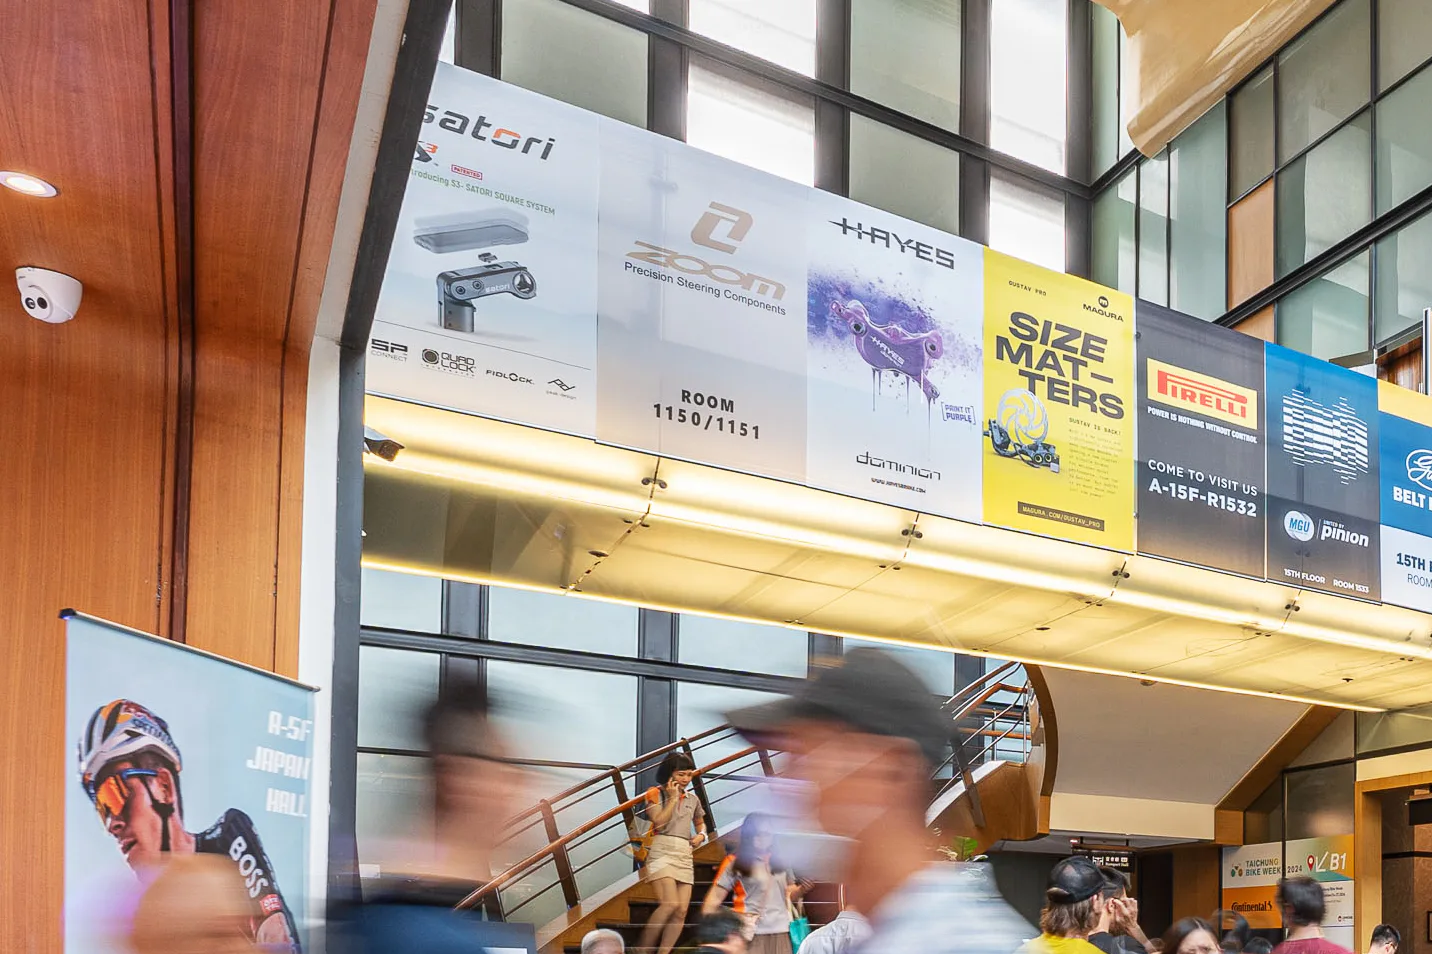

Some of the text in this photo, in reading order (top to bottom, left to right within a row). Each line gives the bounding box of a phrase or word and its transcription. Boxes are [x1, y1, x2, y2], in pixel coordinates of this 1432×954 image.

[465, 183, 493, 198] SATORI
[494, 191, 525, 207] SQUARE
[526, 200, 556, 216] SYSTEM
[829, 217, 955, 270] HAYES
[624, 261, 787, 316] Precision Steering Components
[1082, 303, 1124, 323] MAGURA
[1008, 311, 1108, 363] SIZE
[440, 359, 475, 373] LOCK
[441, 352, 475, 366] QUAD
[681, 389, 735, 413] ROOM
[1018, 368, 1125, 420] TERS
[1157, 369, 1248, 419] PIRELLI
[653, 403, 760, 440] 1150/1151
[1147, 406, 1170, 420] POWER
[1170, 412, 1178, 422] IS
[1178, 415, 1205, 429] NOTHING
[1205, 421, 1232, 437] WITHOUT
[856, 451, 941, 481] dominion
[1148, 459, 1258, 496] COME TO VISIT US
[1148, 477, 1257, 518] A-15F-R1532
[1392, 485, 1426, 509] BELT
[1289, 517, 1311, 533] MGU
[1320, 525, 1369, 547] pinion
[1396, 552, 1426, 571] 15TH
[1283, 568, 1301, 579] 15TH
[1301, 572, 1326, 584] FLOOR
[1333, 579, 1355, 590] ROOM
[1407, 573, 1432, 589] ROOM
[265, 787, 308, 818] HALL
[229, 835, 269, 898] BOSS
[1245, 857, 1279, 868] TAICHUNG
[1245, 864, 1303, 877] BIKE WEEK 2024
[1330, 852, 1347, 871] B1
[1231, 900, 1267, 912] Continental
